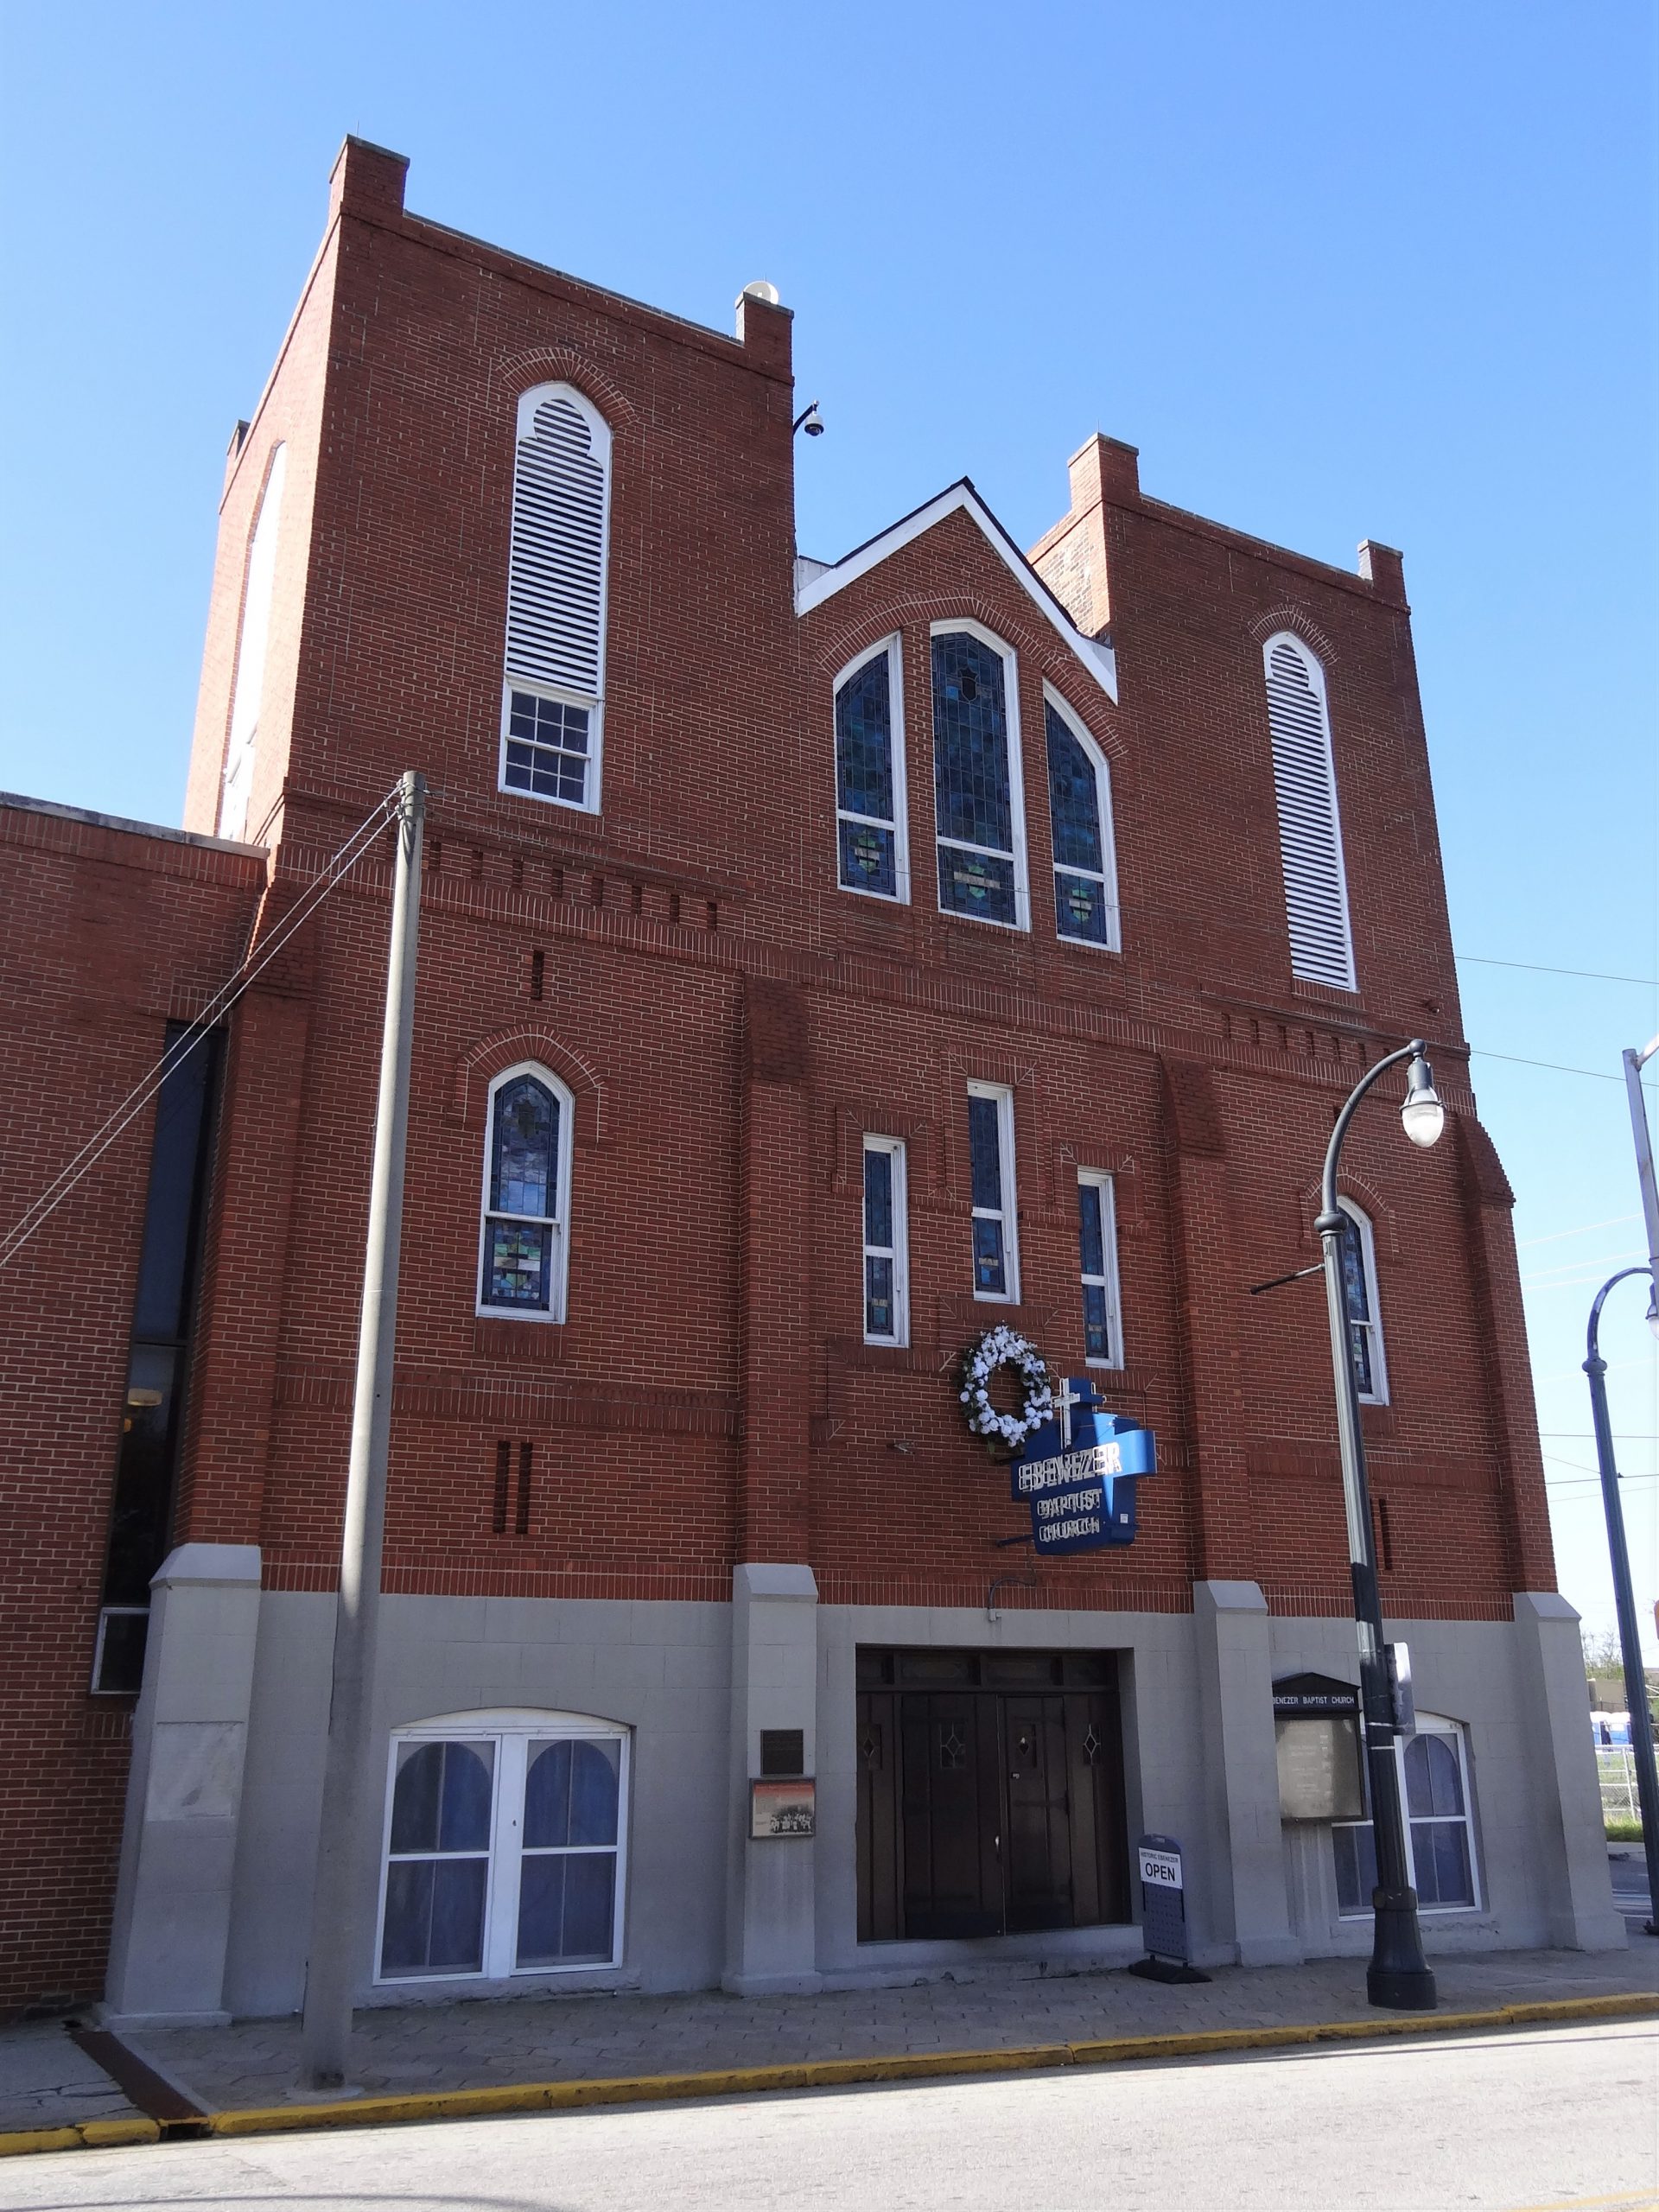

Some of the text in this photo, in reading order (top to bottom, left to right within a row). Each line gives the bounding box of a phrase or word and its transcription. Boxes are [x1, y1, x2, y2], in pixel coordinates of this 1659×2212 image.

[1019, 1441, 1122, 1493] EBENEZER
[1037, 1487, 1103, 1520] BAPTIST
[1039, 1516, 1100, 1542] CHURCH
[1272, 1696, 1355, 1705] BENEZER BAPTIST CHURCH
[1145, 1862, 1176, 1882] OPEN
